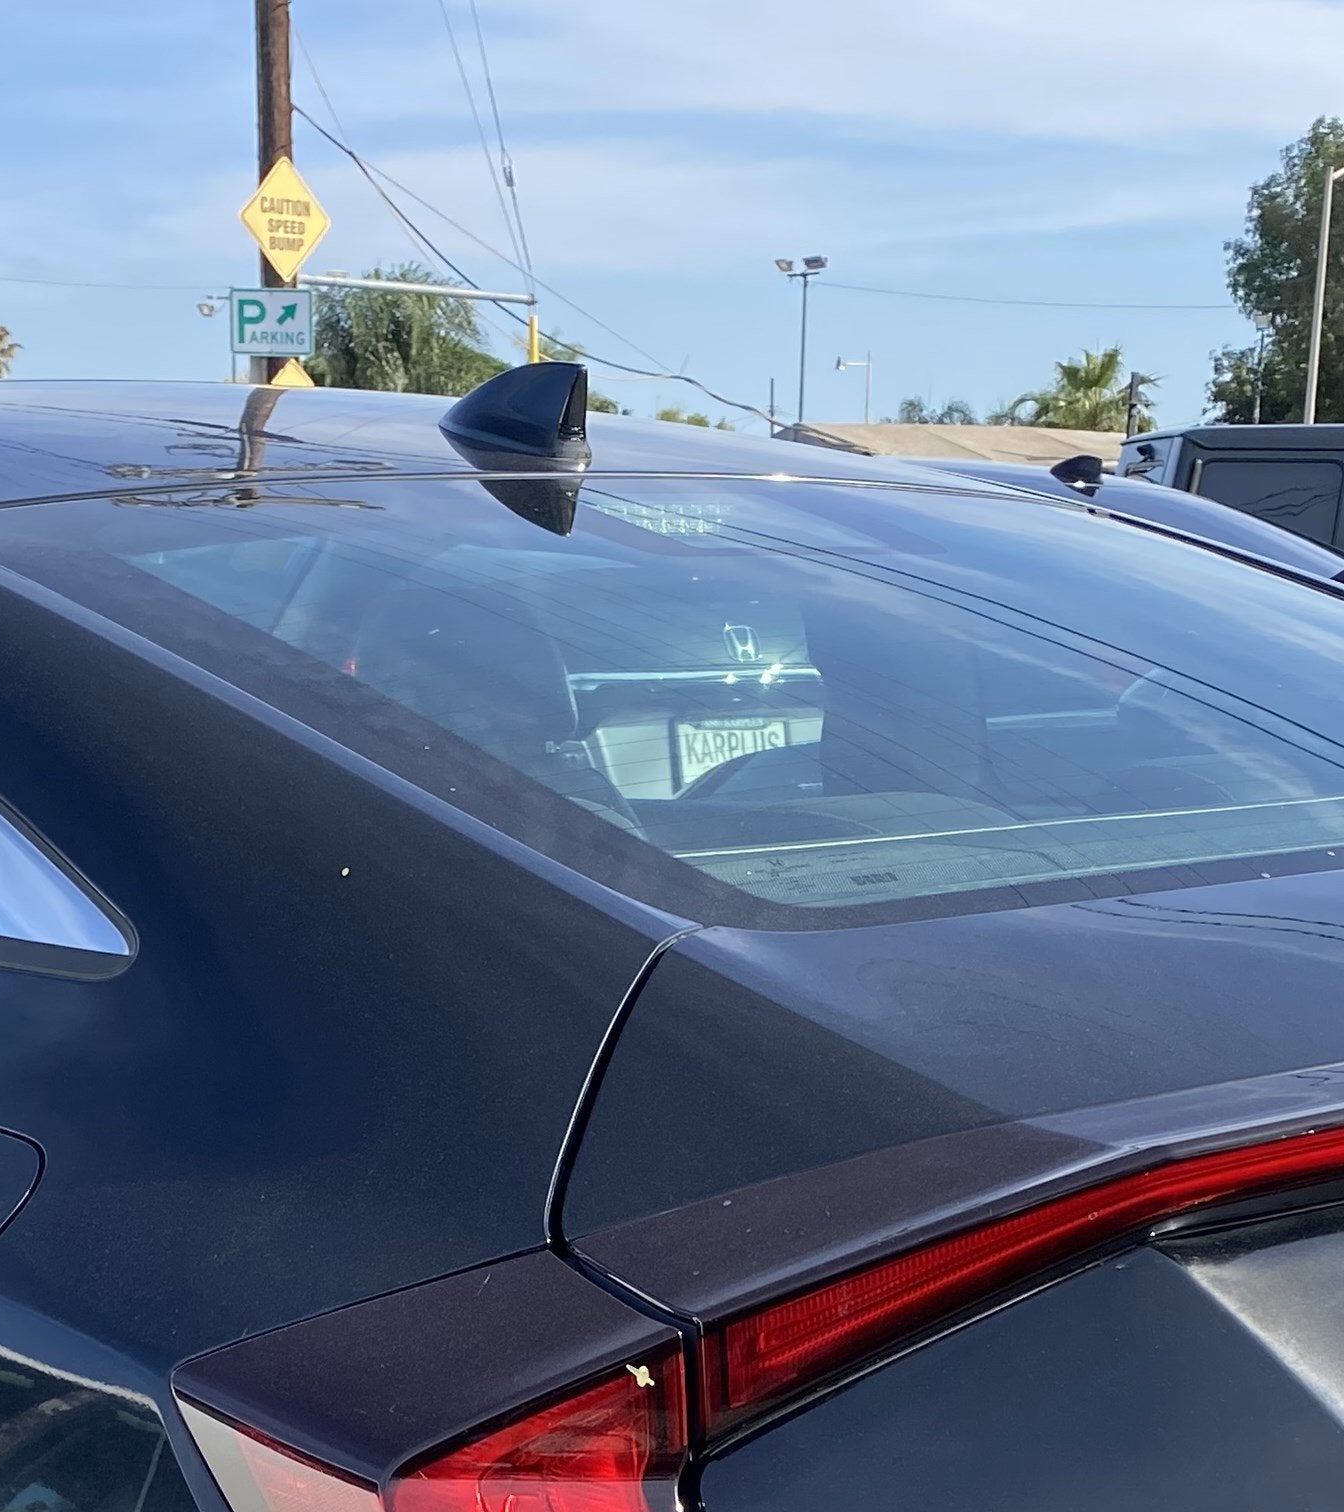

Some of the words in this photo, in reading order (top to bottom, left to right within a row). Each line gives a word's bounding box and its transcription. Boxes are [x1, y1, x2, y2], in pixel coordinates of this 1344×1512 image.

[260, 196, 311, 217] CAUTION
[267, 218, 306, 236] SPEED
[269, 236, 304, 252] BUMP
